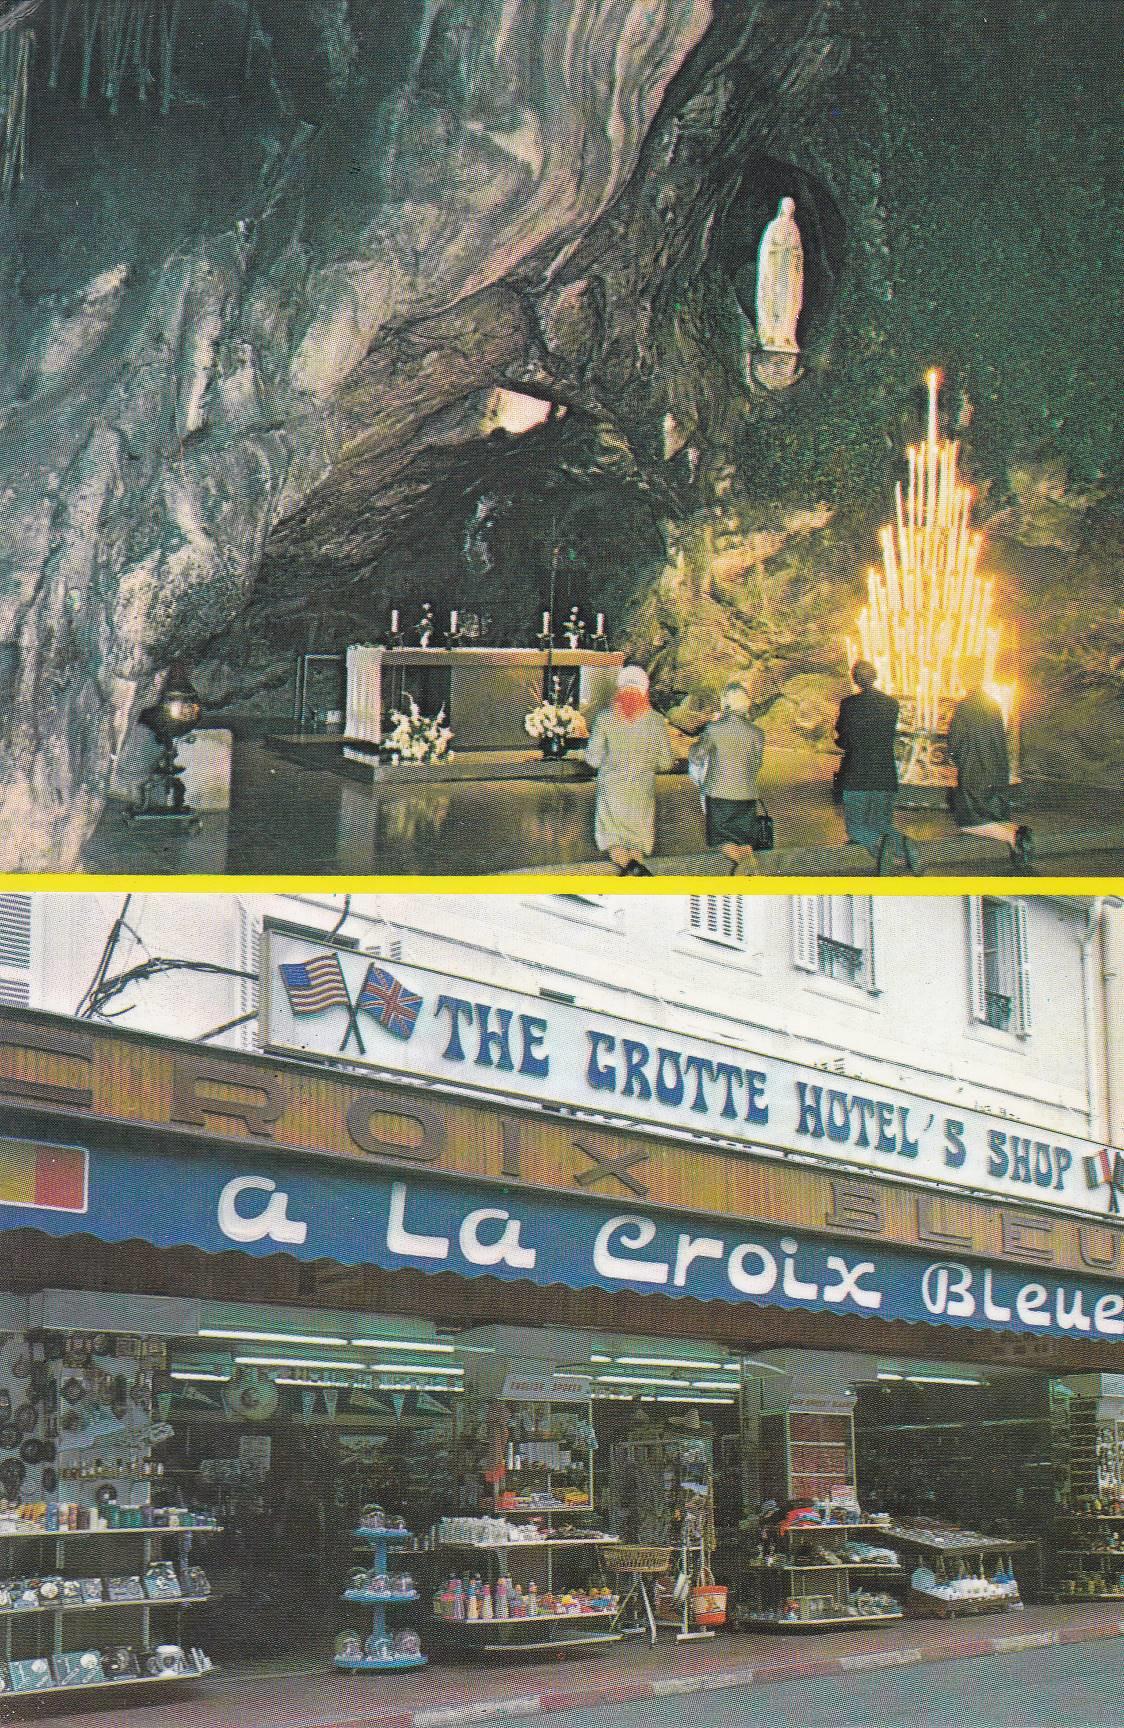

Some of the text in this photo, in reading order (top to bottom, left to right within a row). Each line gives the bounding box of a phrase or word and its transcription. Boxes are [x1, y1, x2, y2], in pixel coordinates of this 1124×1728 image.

[436, 994, 1073, 1191] THE GROTTE HOTEL'S SHOP
[592, 1215, 883, 1309] Croix
